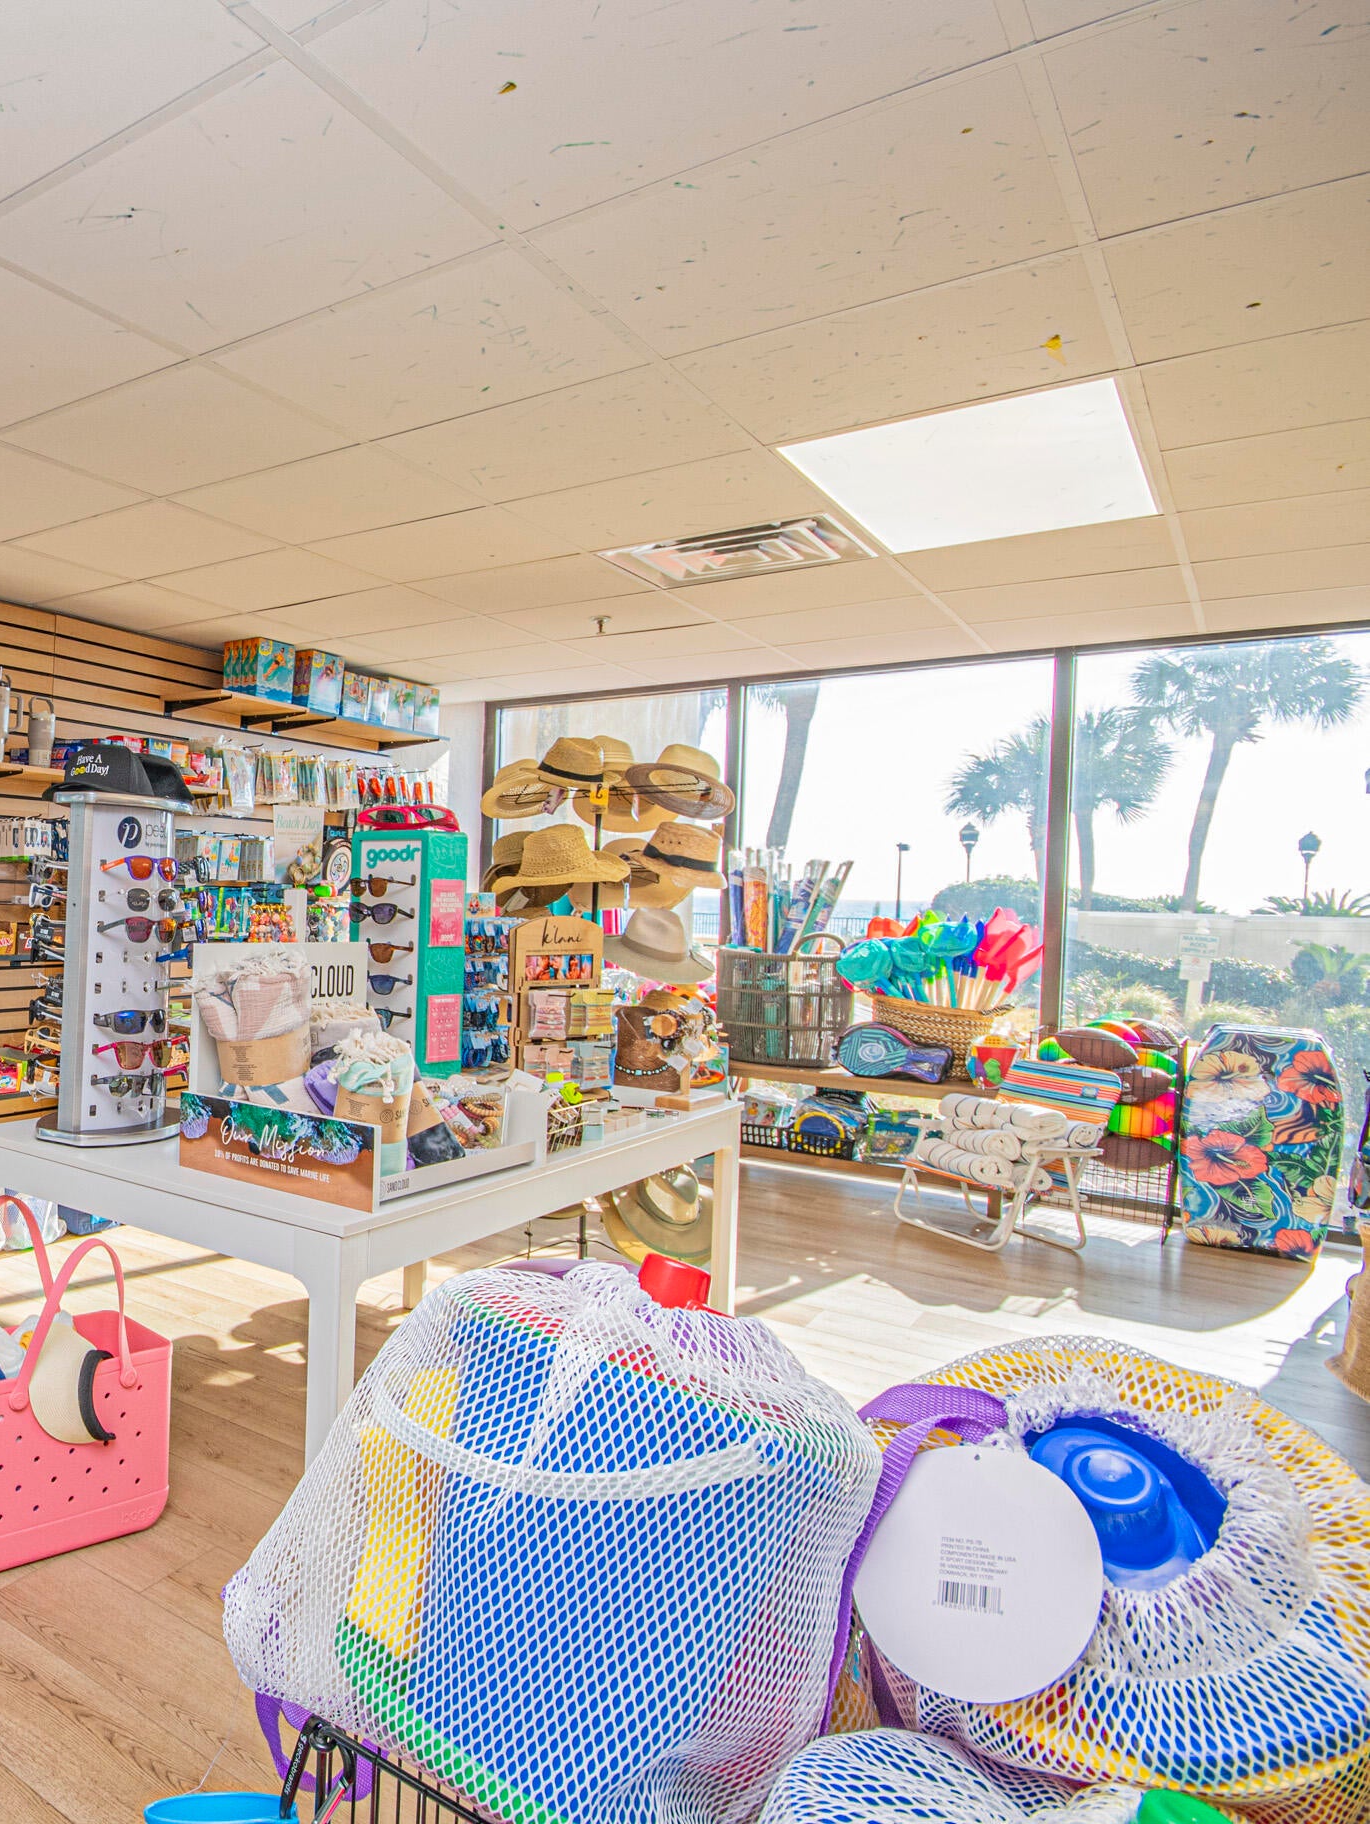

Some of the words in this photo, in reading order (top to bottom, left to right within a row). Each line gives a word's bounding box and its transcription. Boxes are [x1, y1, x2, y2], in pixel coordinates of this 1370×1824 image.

[76, 755, 95, 765] Have
[95, 754, 103, 763] A
[90, 762, 110, 776] Day!
[366, 844, 421, 869] goodr
[311, 965, 354, 999] CLOUD
[220, 1115, 253, 1145] Our
[259, 1123, 329, 1163] Mission
[225, 1151, 231, 1159] OF
[232, 1152, 250, 1165] PROFITS
[250, 1156, 259, 1167] ARE
[259, 1158, 280, 1172] DONATED
[280, 1163, 287, 1173] TO
[287, 1165, 299, 1177] SAVE
[299, 1168, 319, 1181] MARINE
[319, 1173, 331, 1184] LIFE
[386, 1179, 398, 1193] SAND
[398, 1177, 410, 1191] CLOUD
[940, 1543, 965, 1551] PRINTED
[940, 1549, 979, 1559] COMPONENTS
[947, 1563, 980, 1572] VANDERBILT
[981, 1567, 1008, 1575] PARKWAY
[965, 1558, 986, 1566] DESIGN
[283, 1742, 305, 1795] geckobrands
